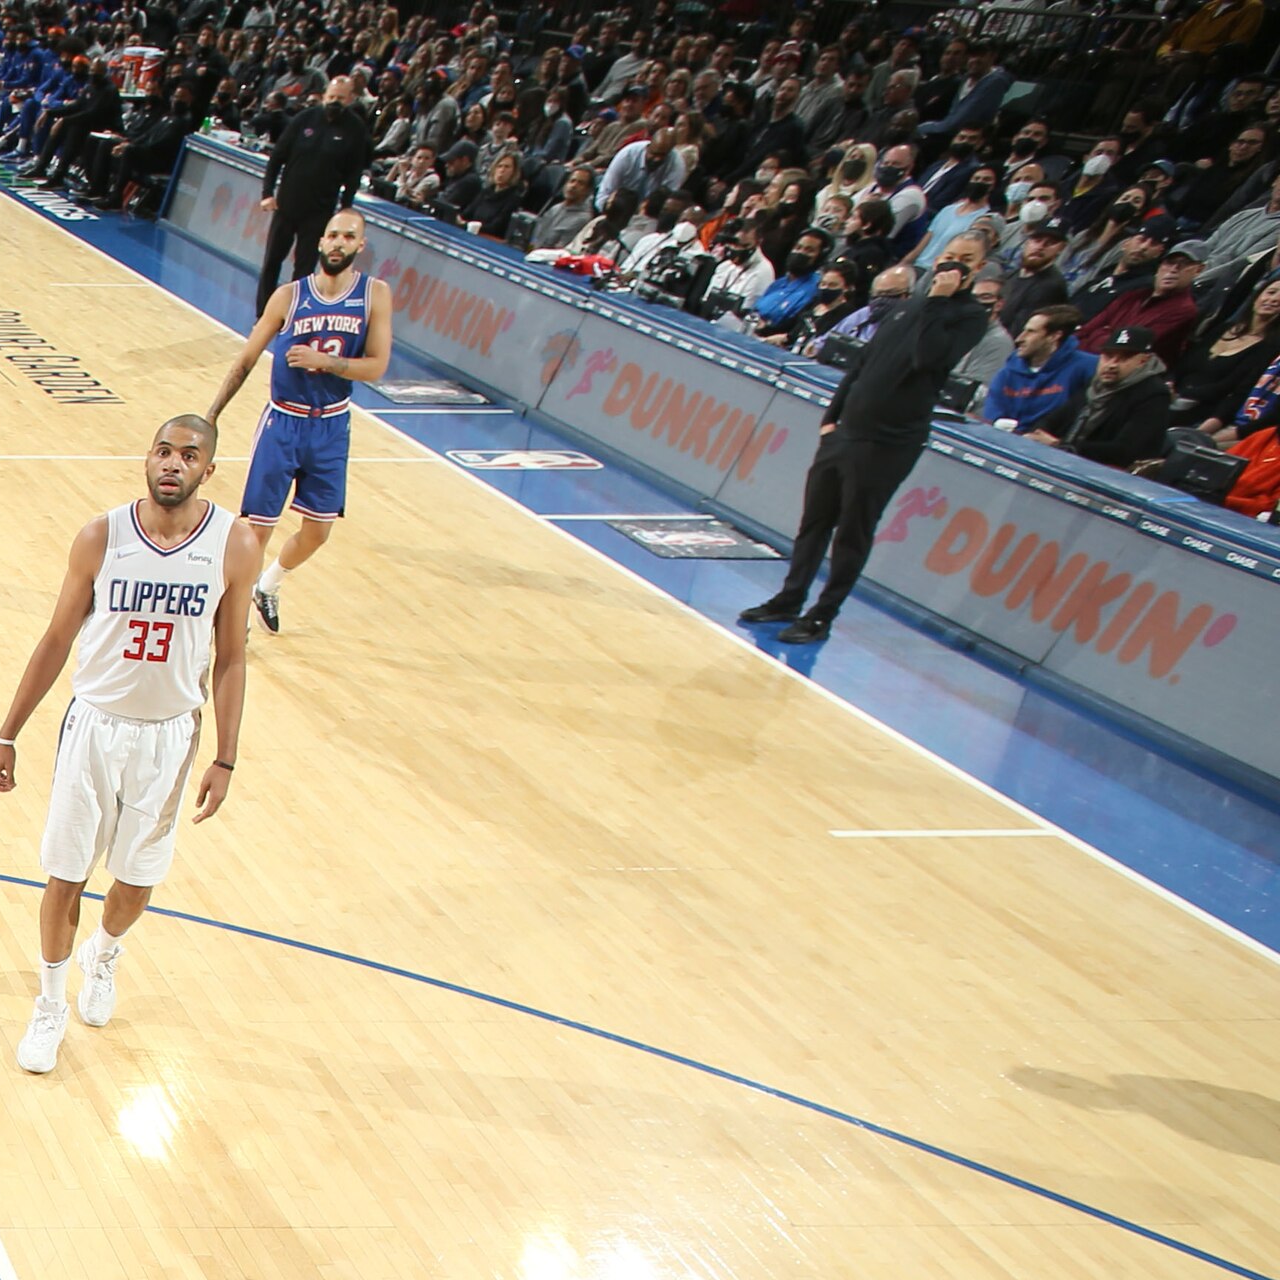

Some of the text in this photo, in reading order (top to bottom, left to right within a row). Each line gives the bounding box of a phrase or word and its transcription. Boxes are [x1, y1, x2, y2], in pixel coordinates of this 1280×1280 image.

[293, 314, 362, 338] NEW YORK
[390, 266, 517, 357] DUNKIN'
[5, 355, 127, 405] GARDEN
[597, 361, 790, 483] DUNKIN'
[1140, 519, 1171, 538] CHASE
[1182, 534, 1214, 554] CHASE
[1225, 551, 1259, 570] CHASE
[108, 577, 209, 617] CLIPPERS
[924, 507, 1239, 682] DUNKIN'
[123, 619, 174, 663] 33
